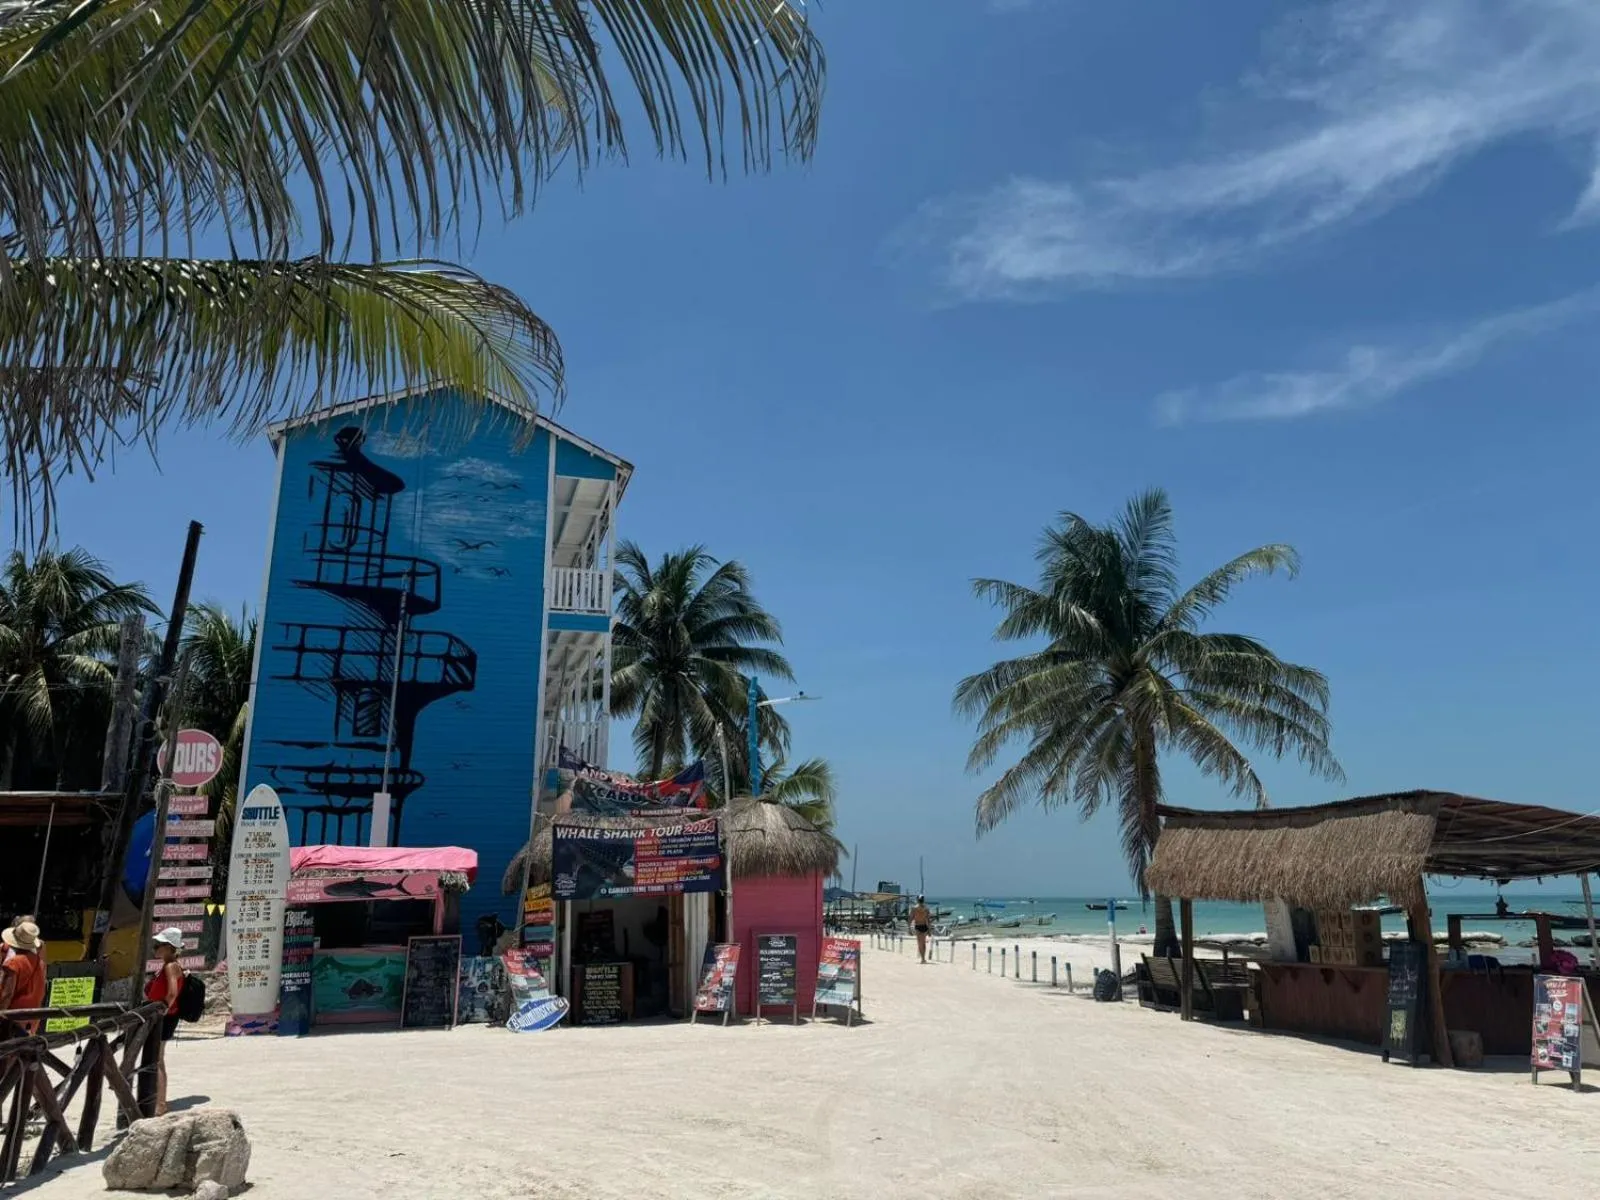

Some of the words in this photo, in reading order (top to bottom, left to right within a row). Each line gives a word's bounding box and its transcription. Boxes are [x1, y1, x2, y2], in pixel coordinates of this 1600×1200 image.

[162, 742, 217, 773] OURS
[241, 806, 281, 820] SHUTTLE
[556, 827, 601, 839] WHALE
[602, 829, 646, 840] SHARK
[649, 824, 682, 839] TOUR
[682, 818, 716, 835] 2024
